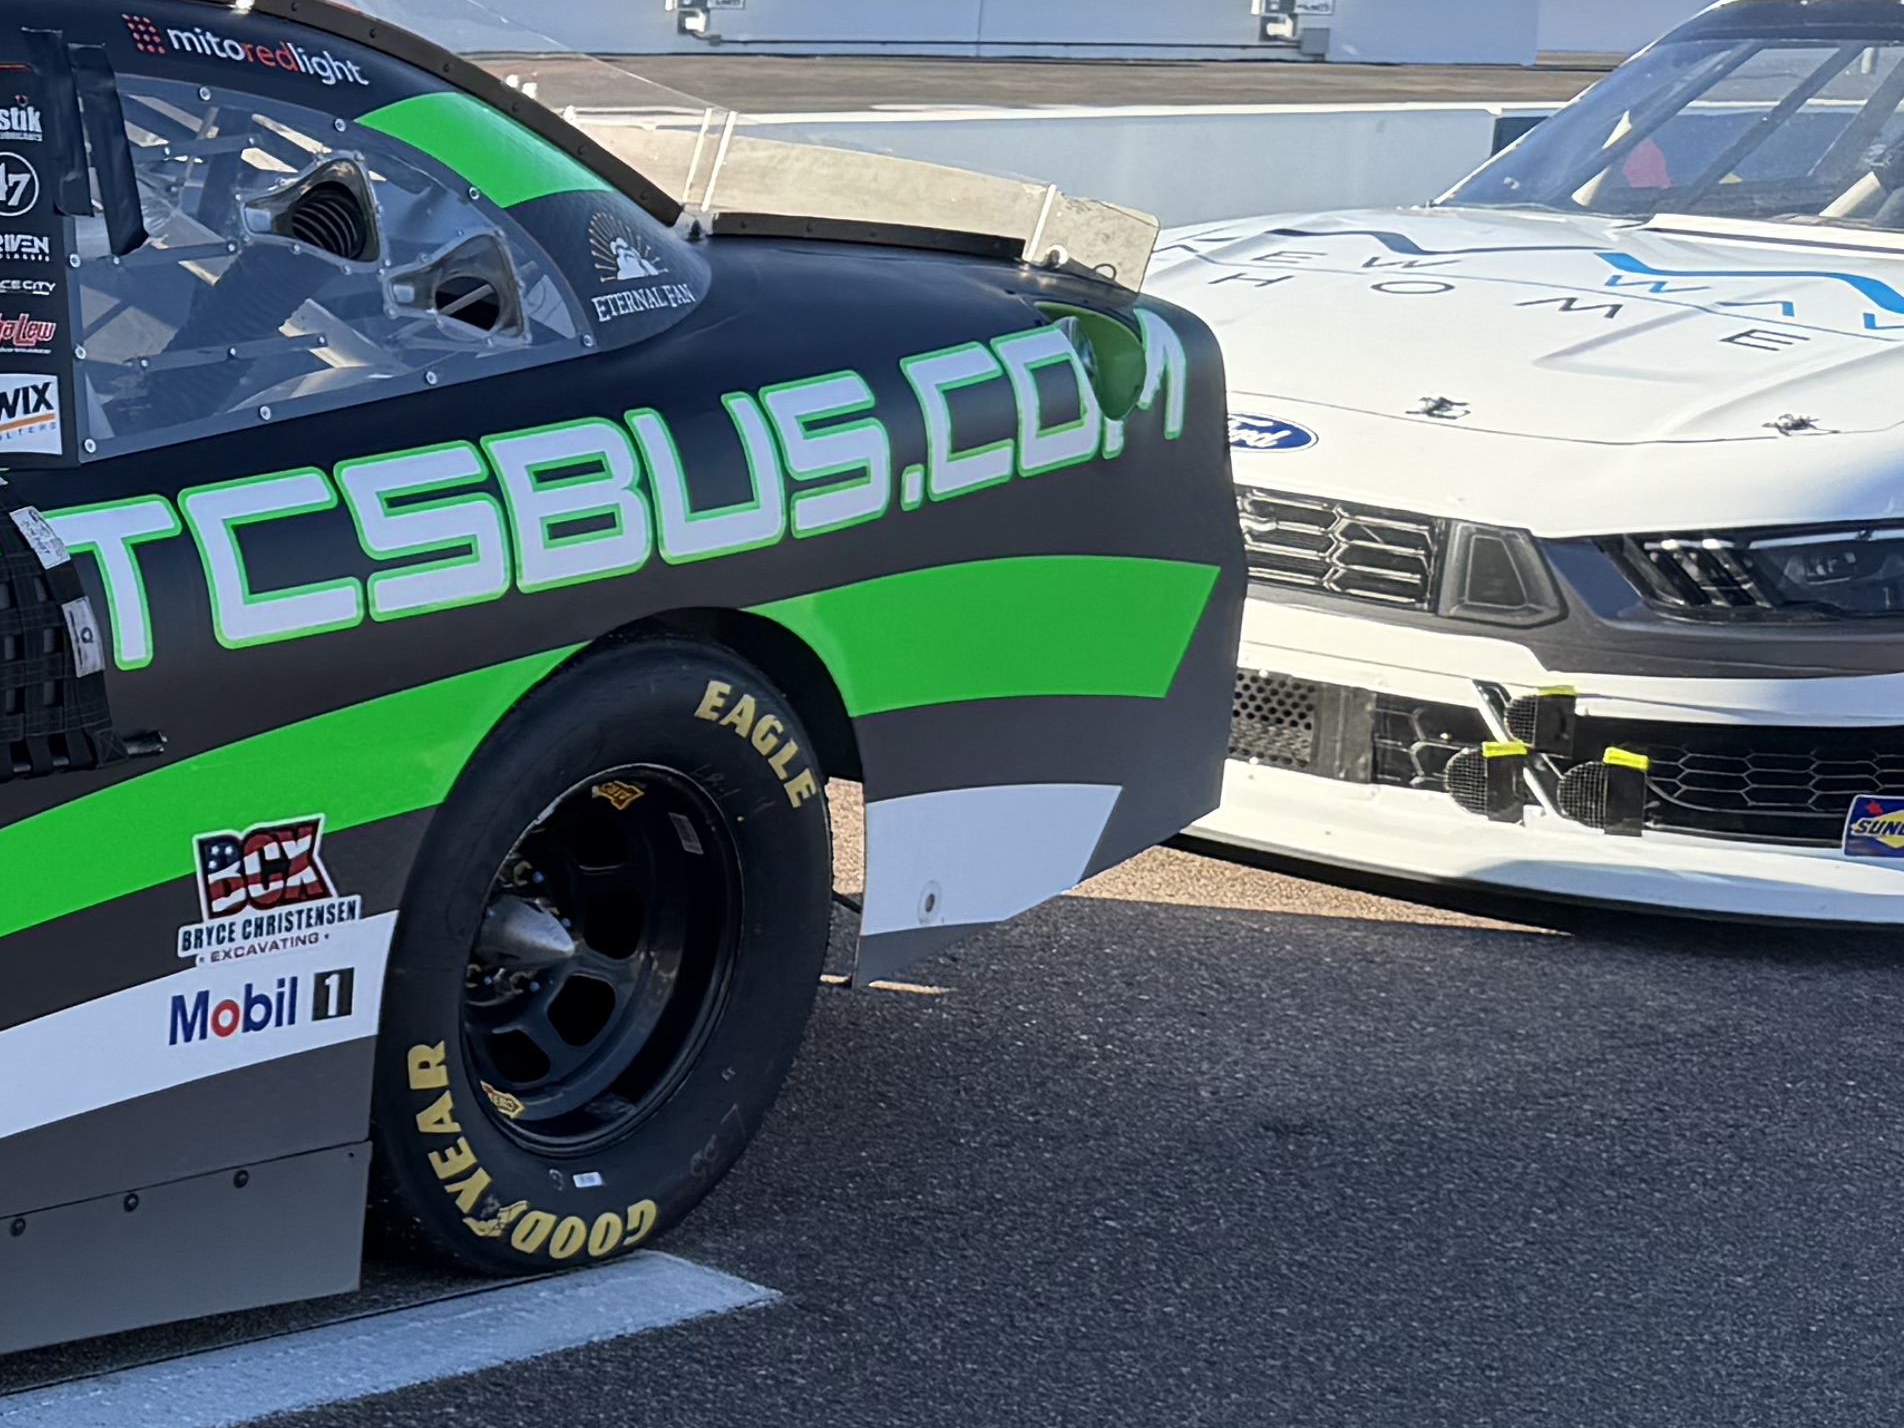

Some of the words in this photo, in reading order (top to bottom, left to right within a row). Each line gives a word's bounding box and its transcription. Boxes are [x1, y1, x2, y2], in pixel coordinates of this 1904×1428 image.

[167, 27, 369, 86] mitoredlight
[591, 287, 669, 322] ETERNAL
[662, 283, 696, 308] FAN
[695, 679, 821, 810] EAGLE
[1853, 819, 1904, 835] SUN
[202, 820, 327, 916] BCX
[181, 922, 237, 952] BRYCE
[241, 899, 358, 940] CHRISTENSEN
[210, 932, 320, 963] EXCAVATING
[168, 976, 298, 1046] Mobil
[324, 973, 340, 1016] 1
[406, 1039, 658, 1261] GOODYEAR
